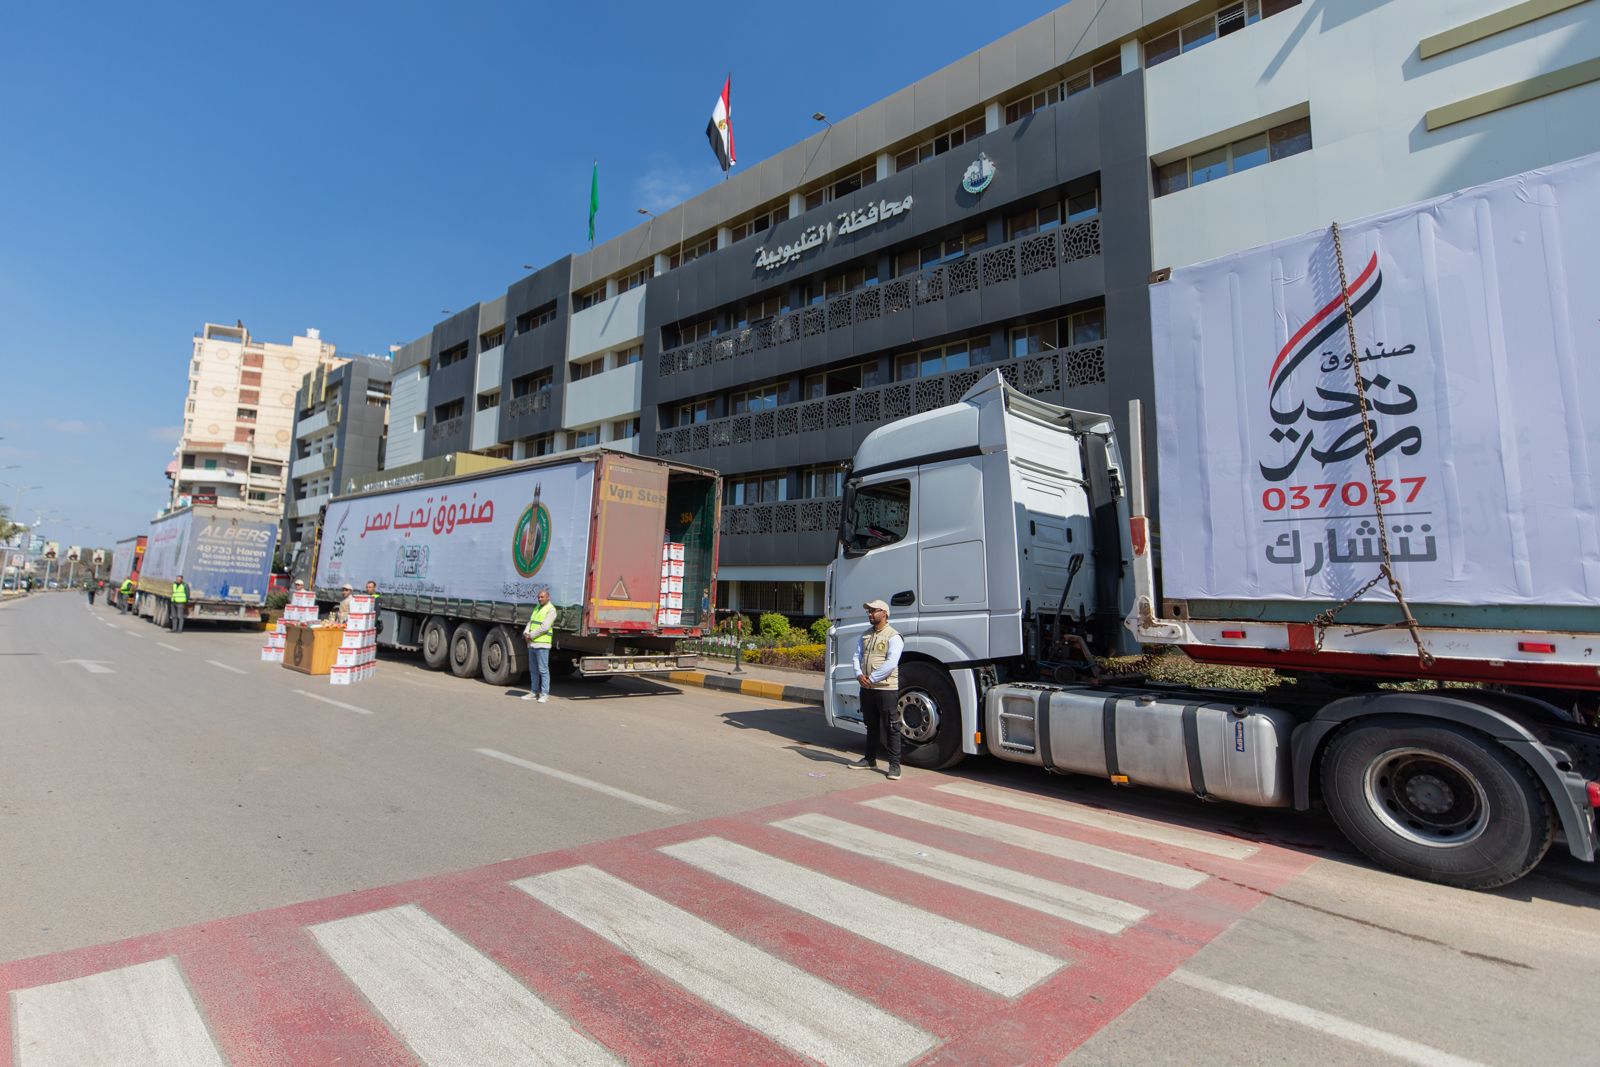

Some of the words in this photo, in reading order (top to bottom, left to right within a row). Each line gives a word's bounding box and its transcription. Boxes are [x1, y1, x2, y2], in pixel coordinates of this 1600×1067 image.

[838, 194, 914, 237] محافظة
[755, 221, 833, 271] القليوبية
[1320, 341, 1416, 374] صندوق
[1258, 418, 1423, 483] مصر
[609, 484, 632, 499] Van
[1262, 476, 1428, 513] 037037
[359, 511, 392, 539] مصر
[393, 497, 433, 538] تحيا
[432, 492, 494, 536] صندوق
[197, 544, 232, 555] 49733
[236, 547, 266, 558] Haren
[199, 525, 271, 543] ALBERS
[1264, 519, 1438, 578] نتشارك
